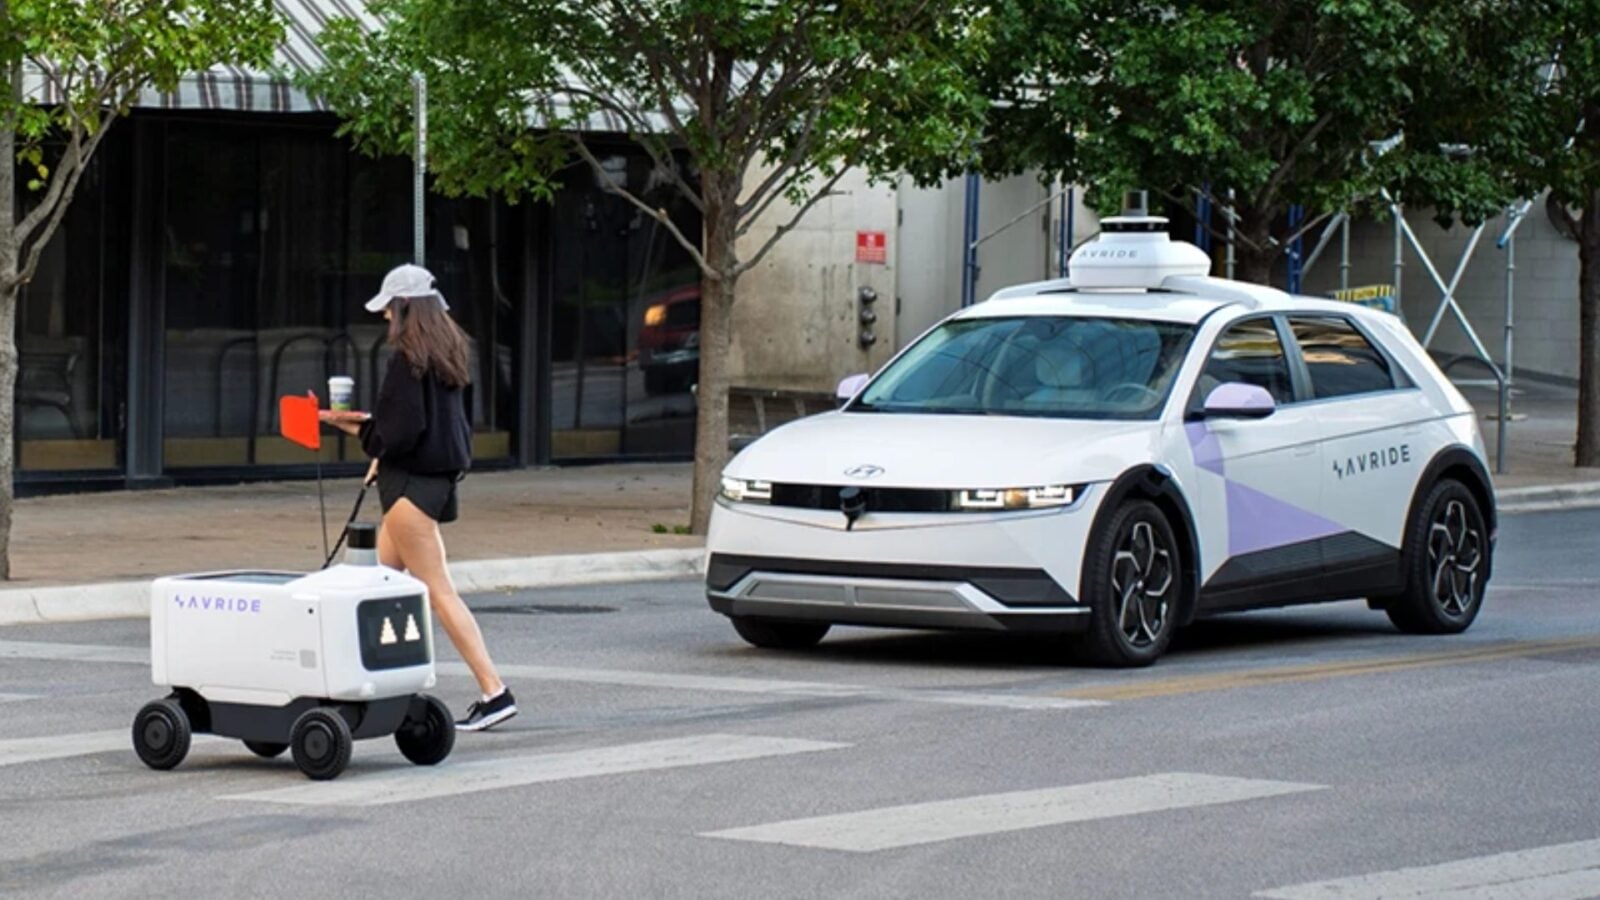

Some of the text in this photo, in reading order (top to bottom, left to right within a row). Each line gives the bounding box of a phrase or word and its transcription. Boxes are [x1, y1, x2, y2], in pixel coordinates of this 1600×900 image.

[1080, 249, 1138, 258] AVRIDE
[1346, 444, 1410, 476] AVRIDE
[188, 596, 261, 612] AVRIDE
